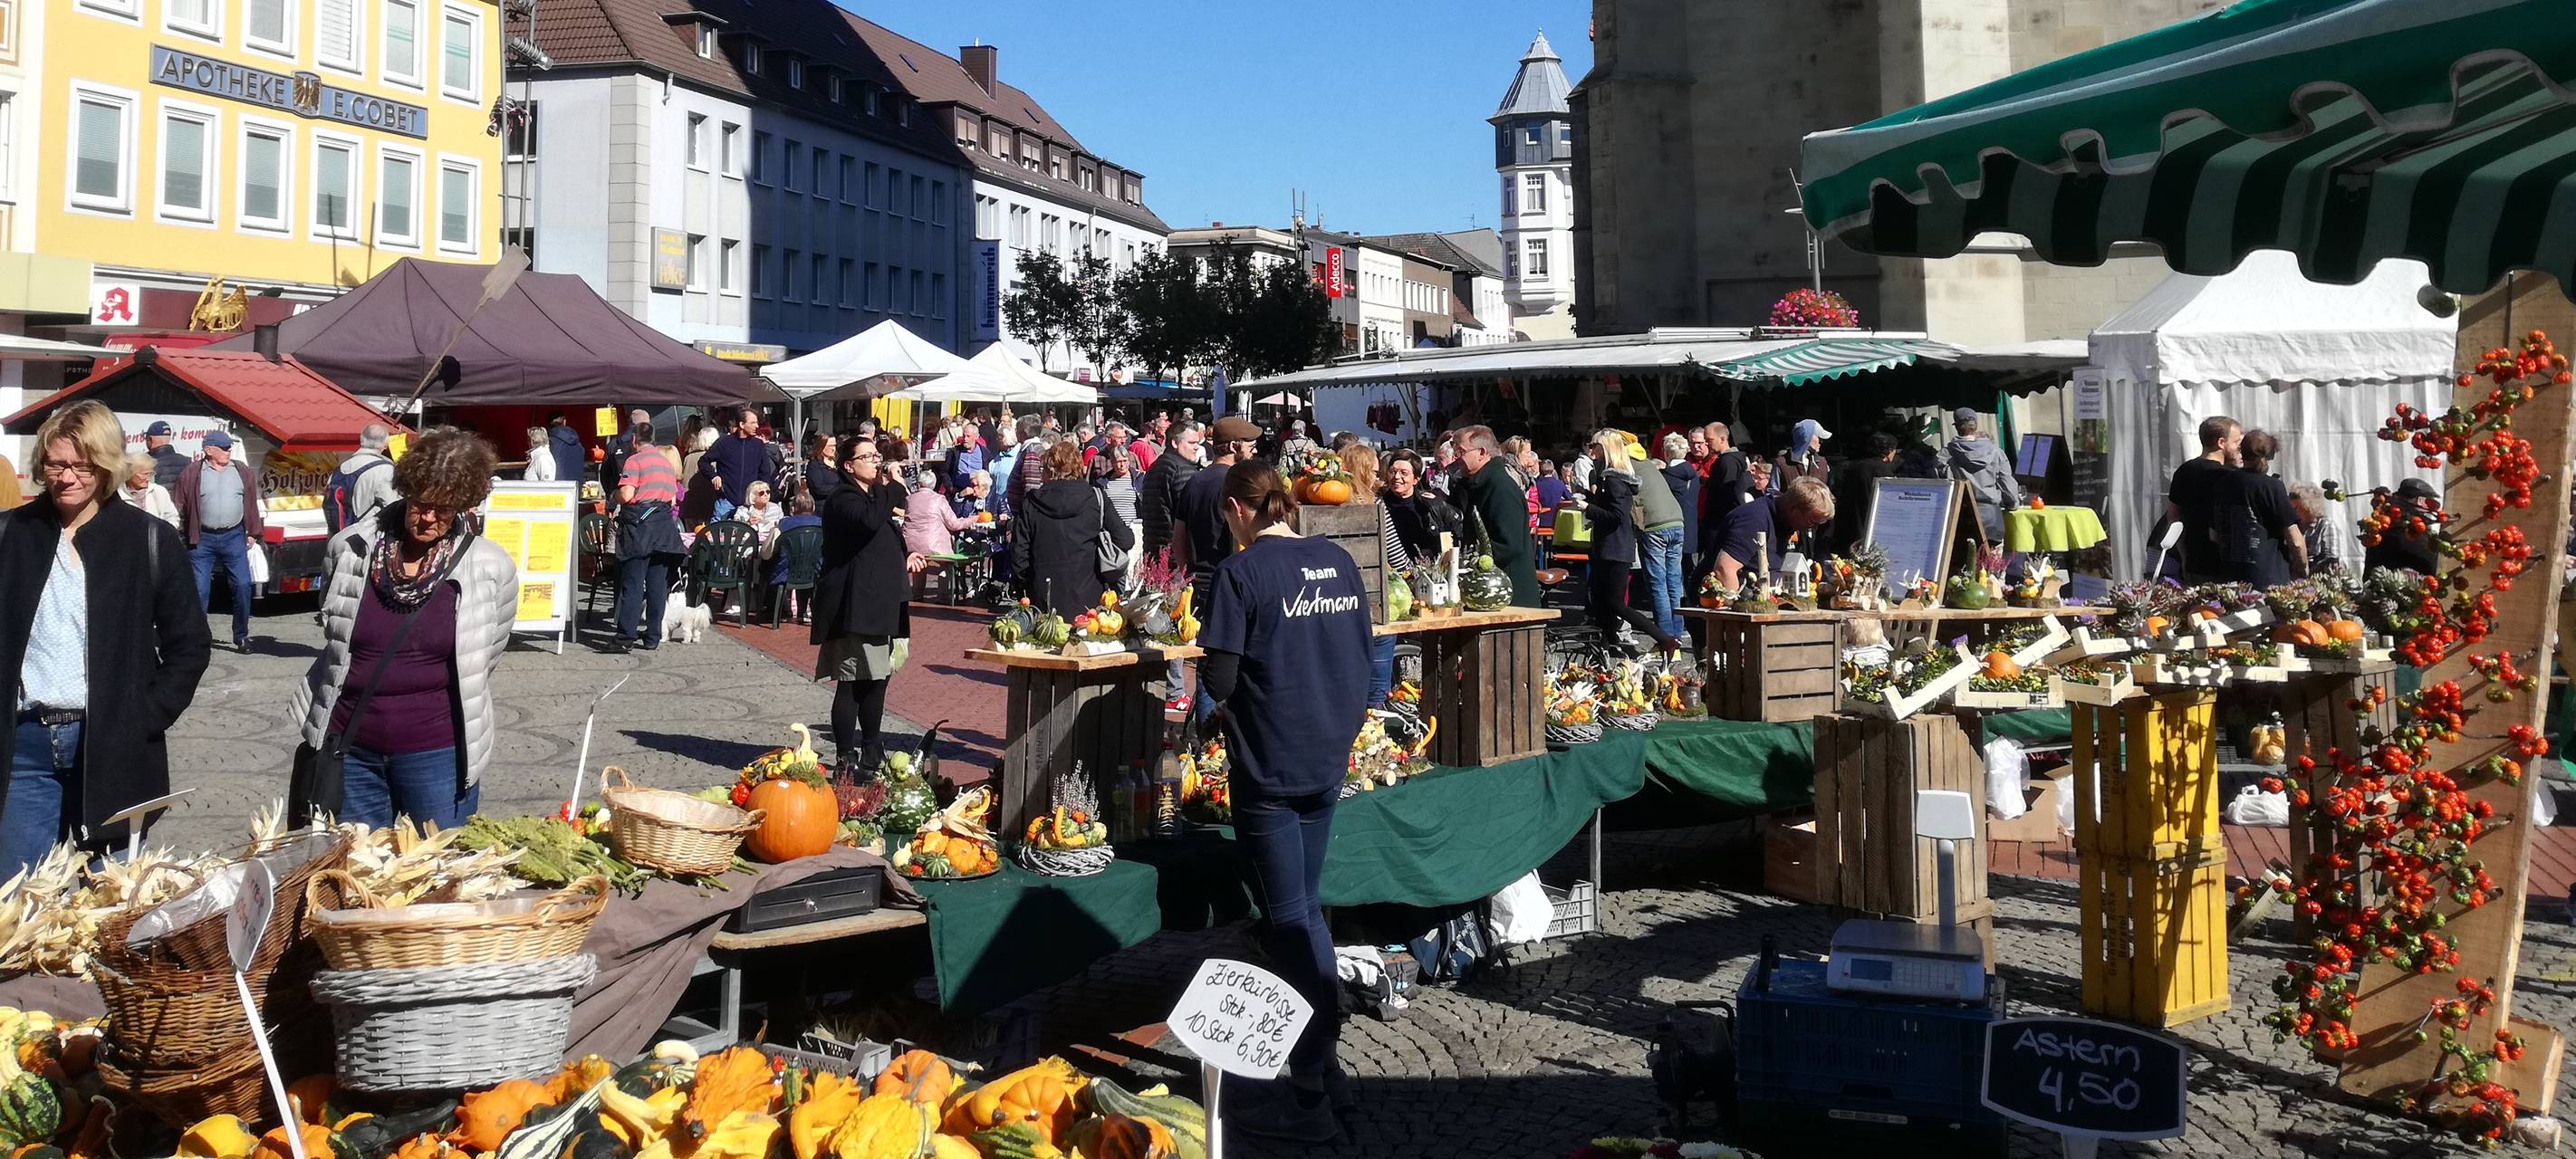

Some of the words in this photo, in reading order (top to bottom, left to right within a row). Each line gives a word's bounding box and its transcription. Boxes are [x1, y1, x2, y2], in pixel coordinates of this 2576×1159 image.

[159, 53, 284, 105] APOTHEKE
[1330, 254, 1340, 292] Adecco
[260, 465, 329, 495] Holzofe
[1301, 567, 1337, 580] Team
[1185, 1011, 1206, 1033] 10
[1236, 1034, 1283, 1068] 6,90€
[2038, 1066, 2141, 1113] 4,50
